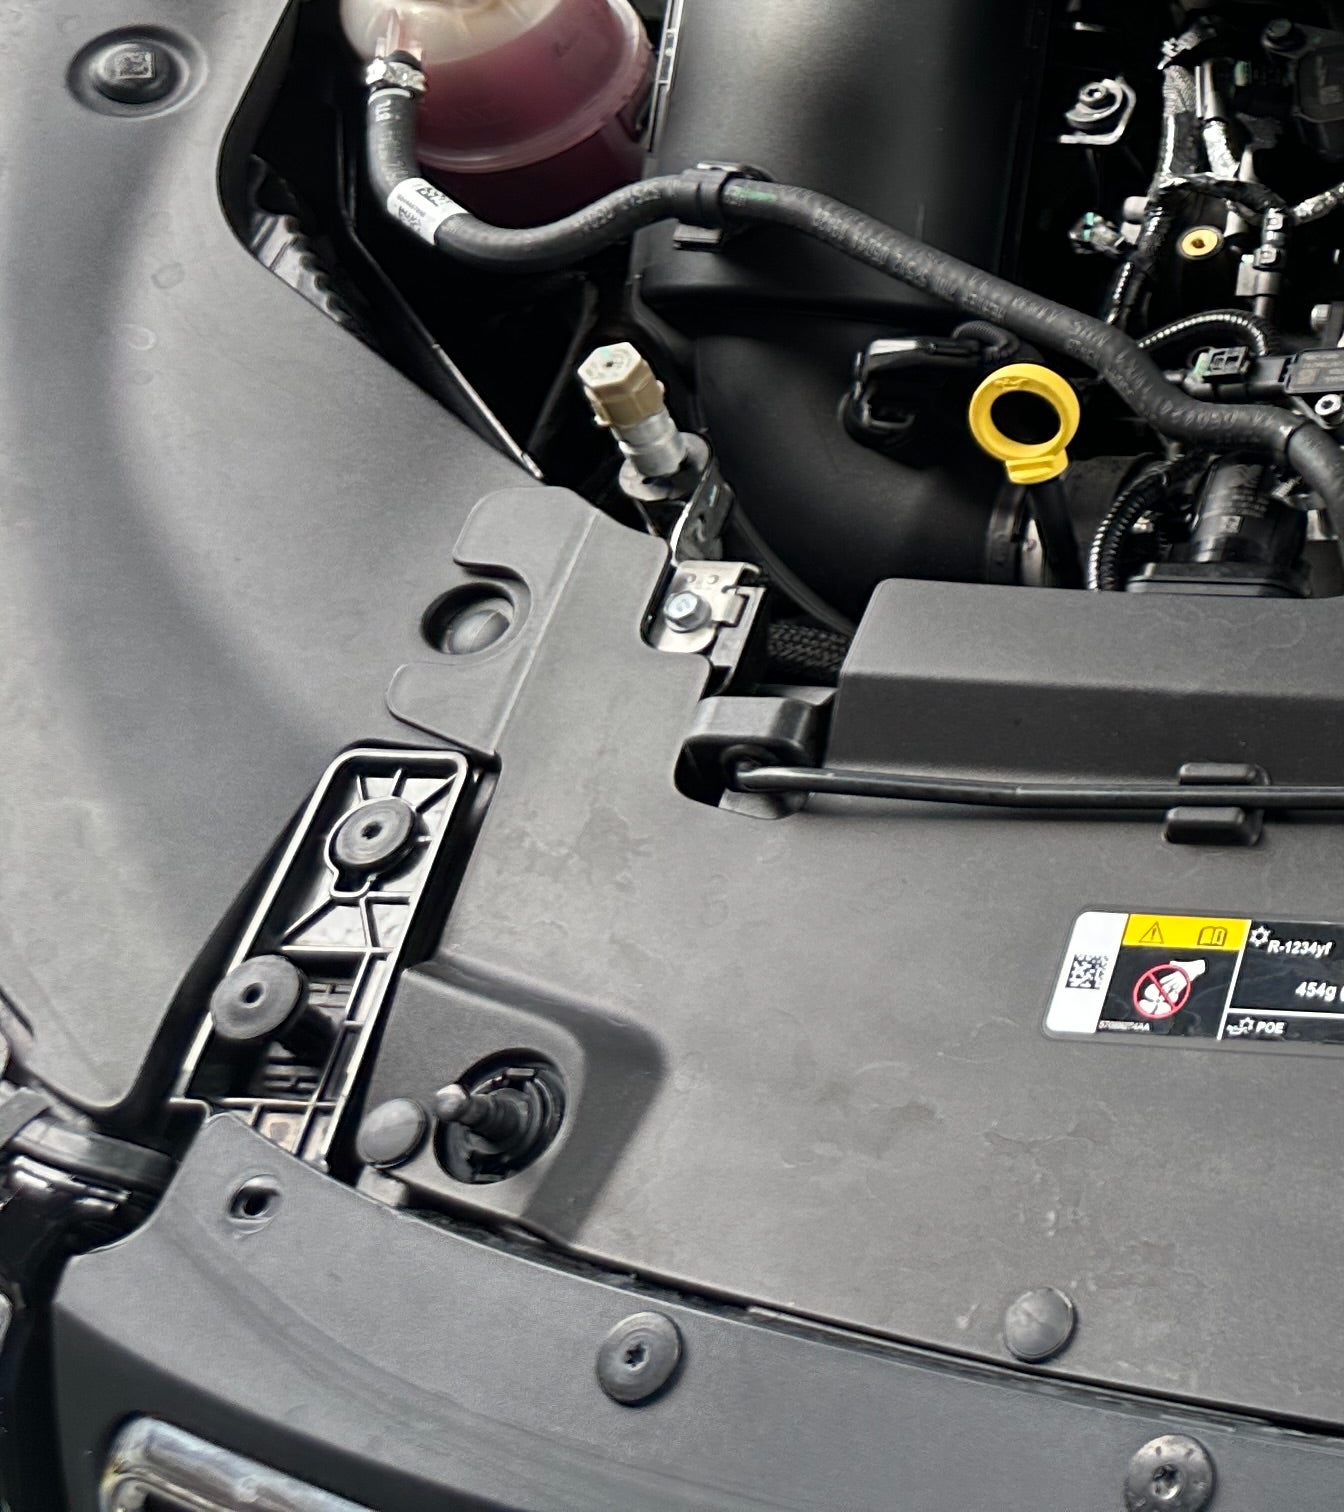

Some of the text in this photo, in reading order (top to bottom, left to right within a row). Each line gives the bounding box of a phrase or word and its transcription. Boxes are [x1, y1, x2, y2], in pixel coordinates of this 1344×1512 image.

[1267, 940, 1333, 959] R-1234yf
[1295, 981, 1337, 1002] 454g
[1255, 1021, 1285, 1034] POE
